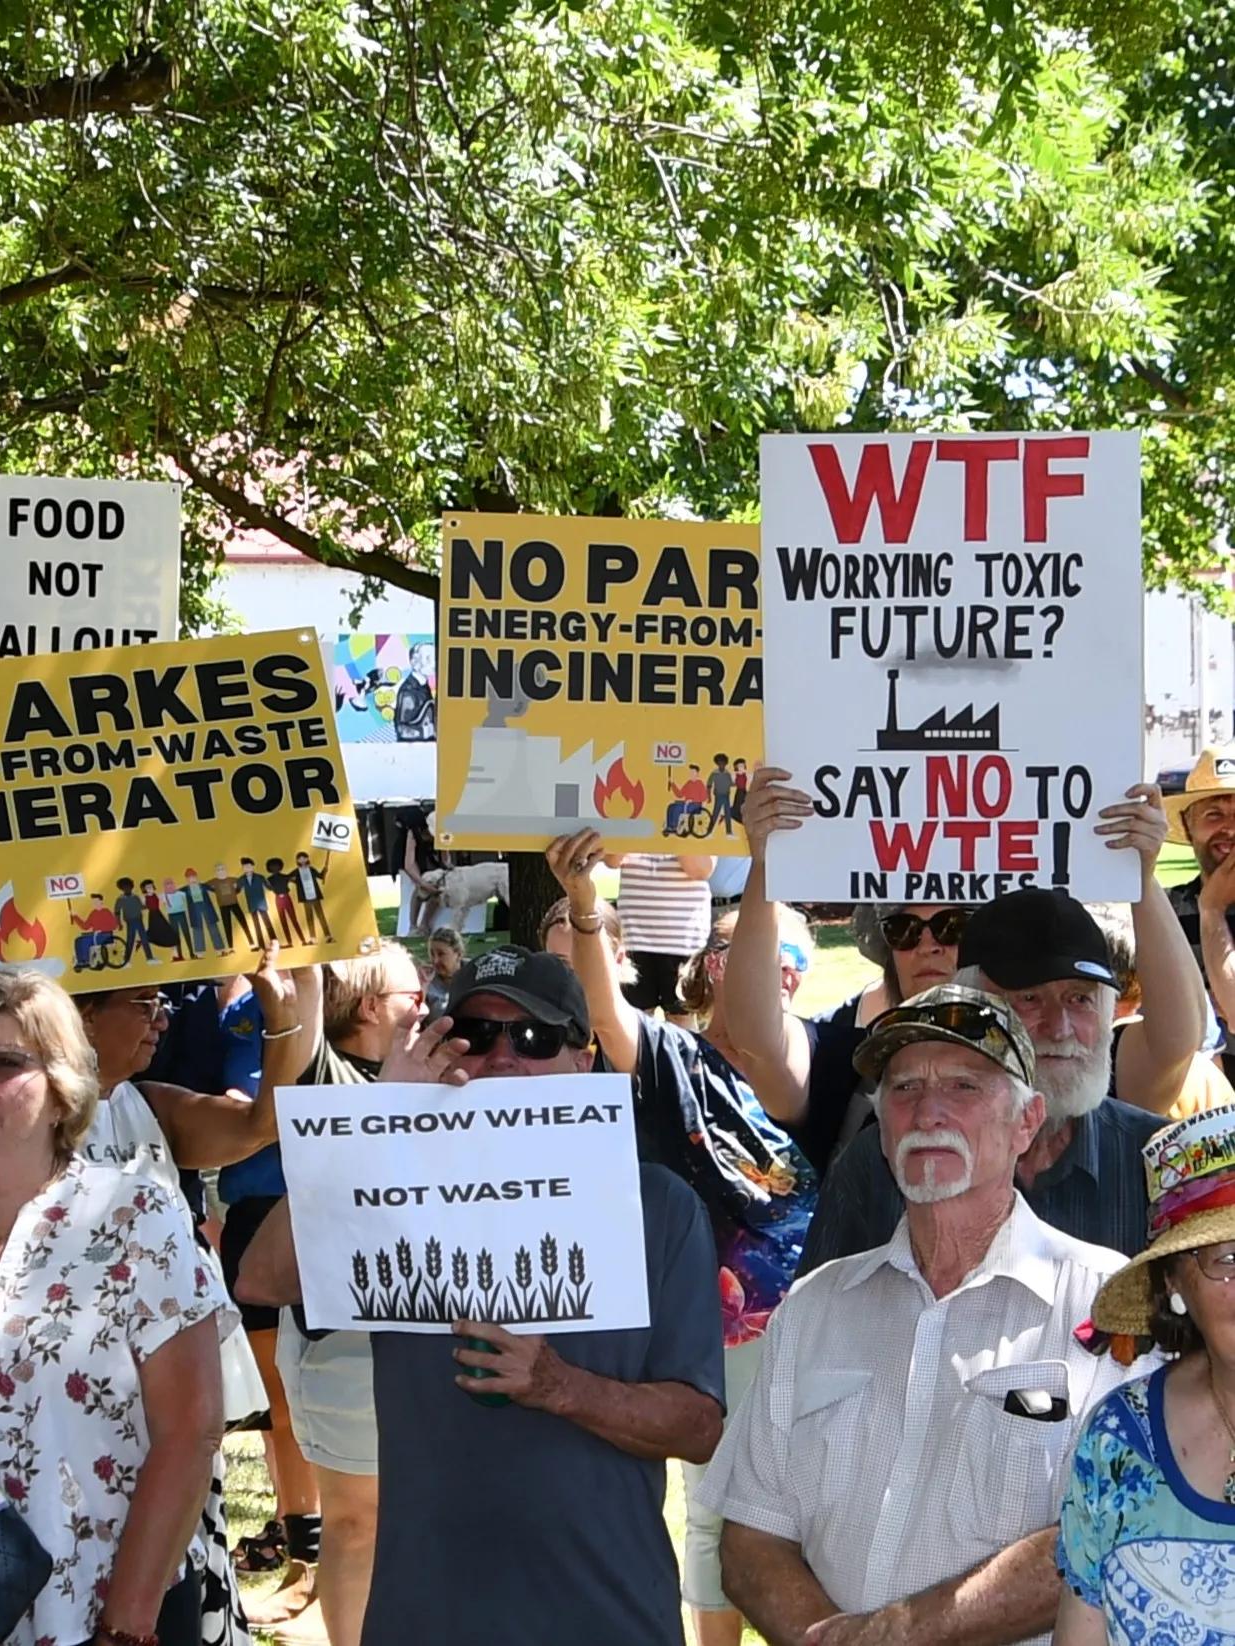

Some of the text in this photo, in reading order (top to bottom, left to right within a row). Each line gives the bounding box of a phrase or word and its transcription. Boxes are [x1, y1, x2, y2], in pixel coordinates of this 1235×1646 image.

[808, 437, 1090, 543] WTF
[9, 498, 124, 540] FOOD
[29, 561, 103, 597] NOT
[451, 539, 564, 602] NO
[776, 547, 1083, 601] WORRYING TOXIC
[831, 605, 1064, 661] FUTURE?
[657, 745, 681, 759] NO
[813, 757, 1092, 819] SAY NO TO
[317, 820, 350, 839] NO
[50, 876, 79, 892] NO
[850, 871, 888, 899] IN
[292, 1105, 622, 1136] WE GROW WHEAT
[1187, 1106, 1229, 1126] WASTE
[354, 1178, 571, 1206] NOT WASTE
